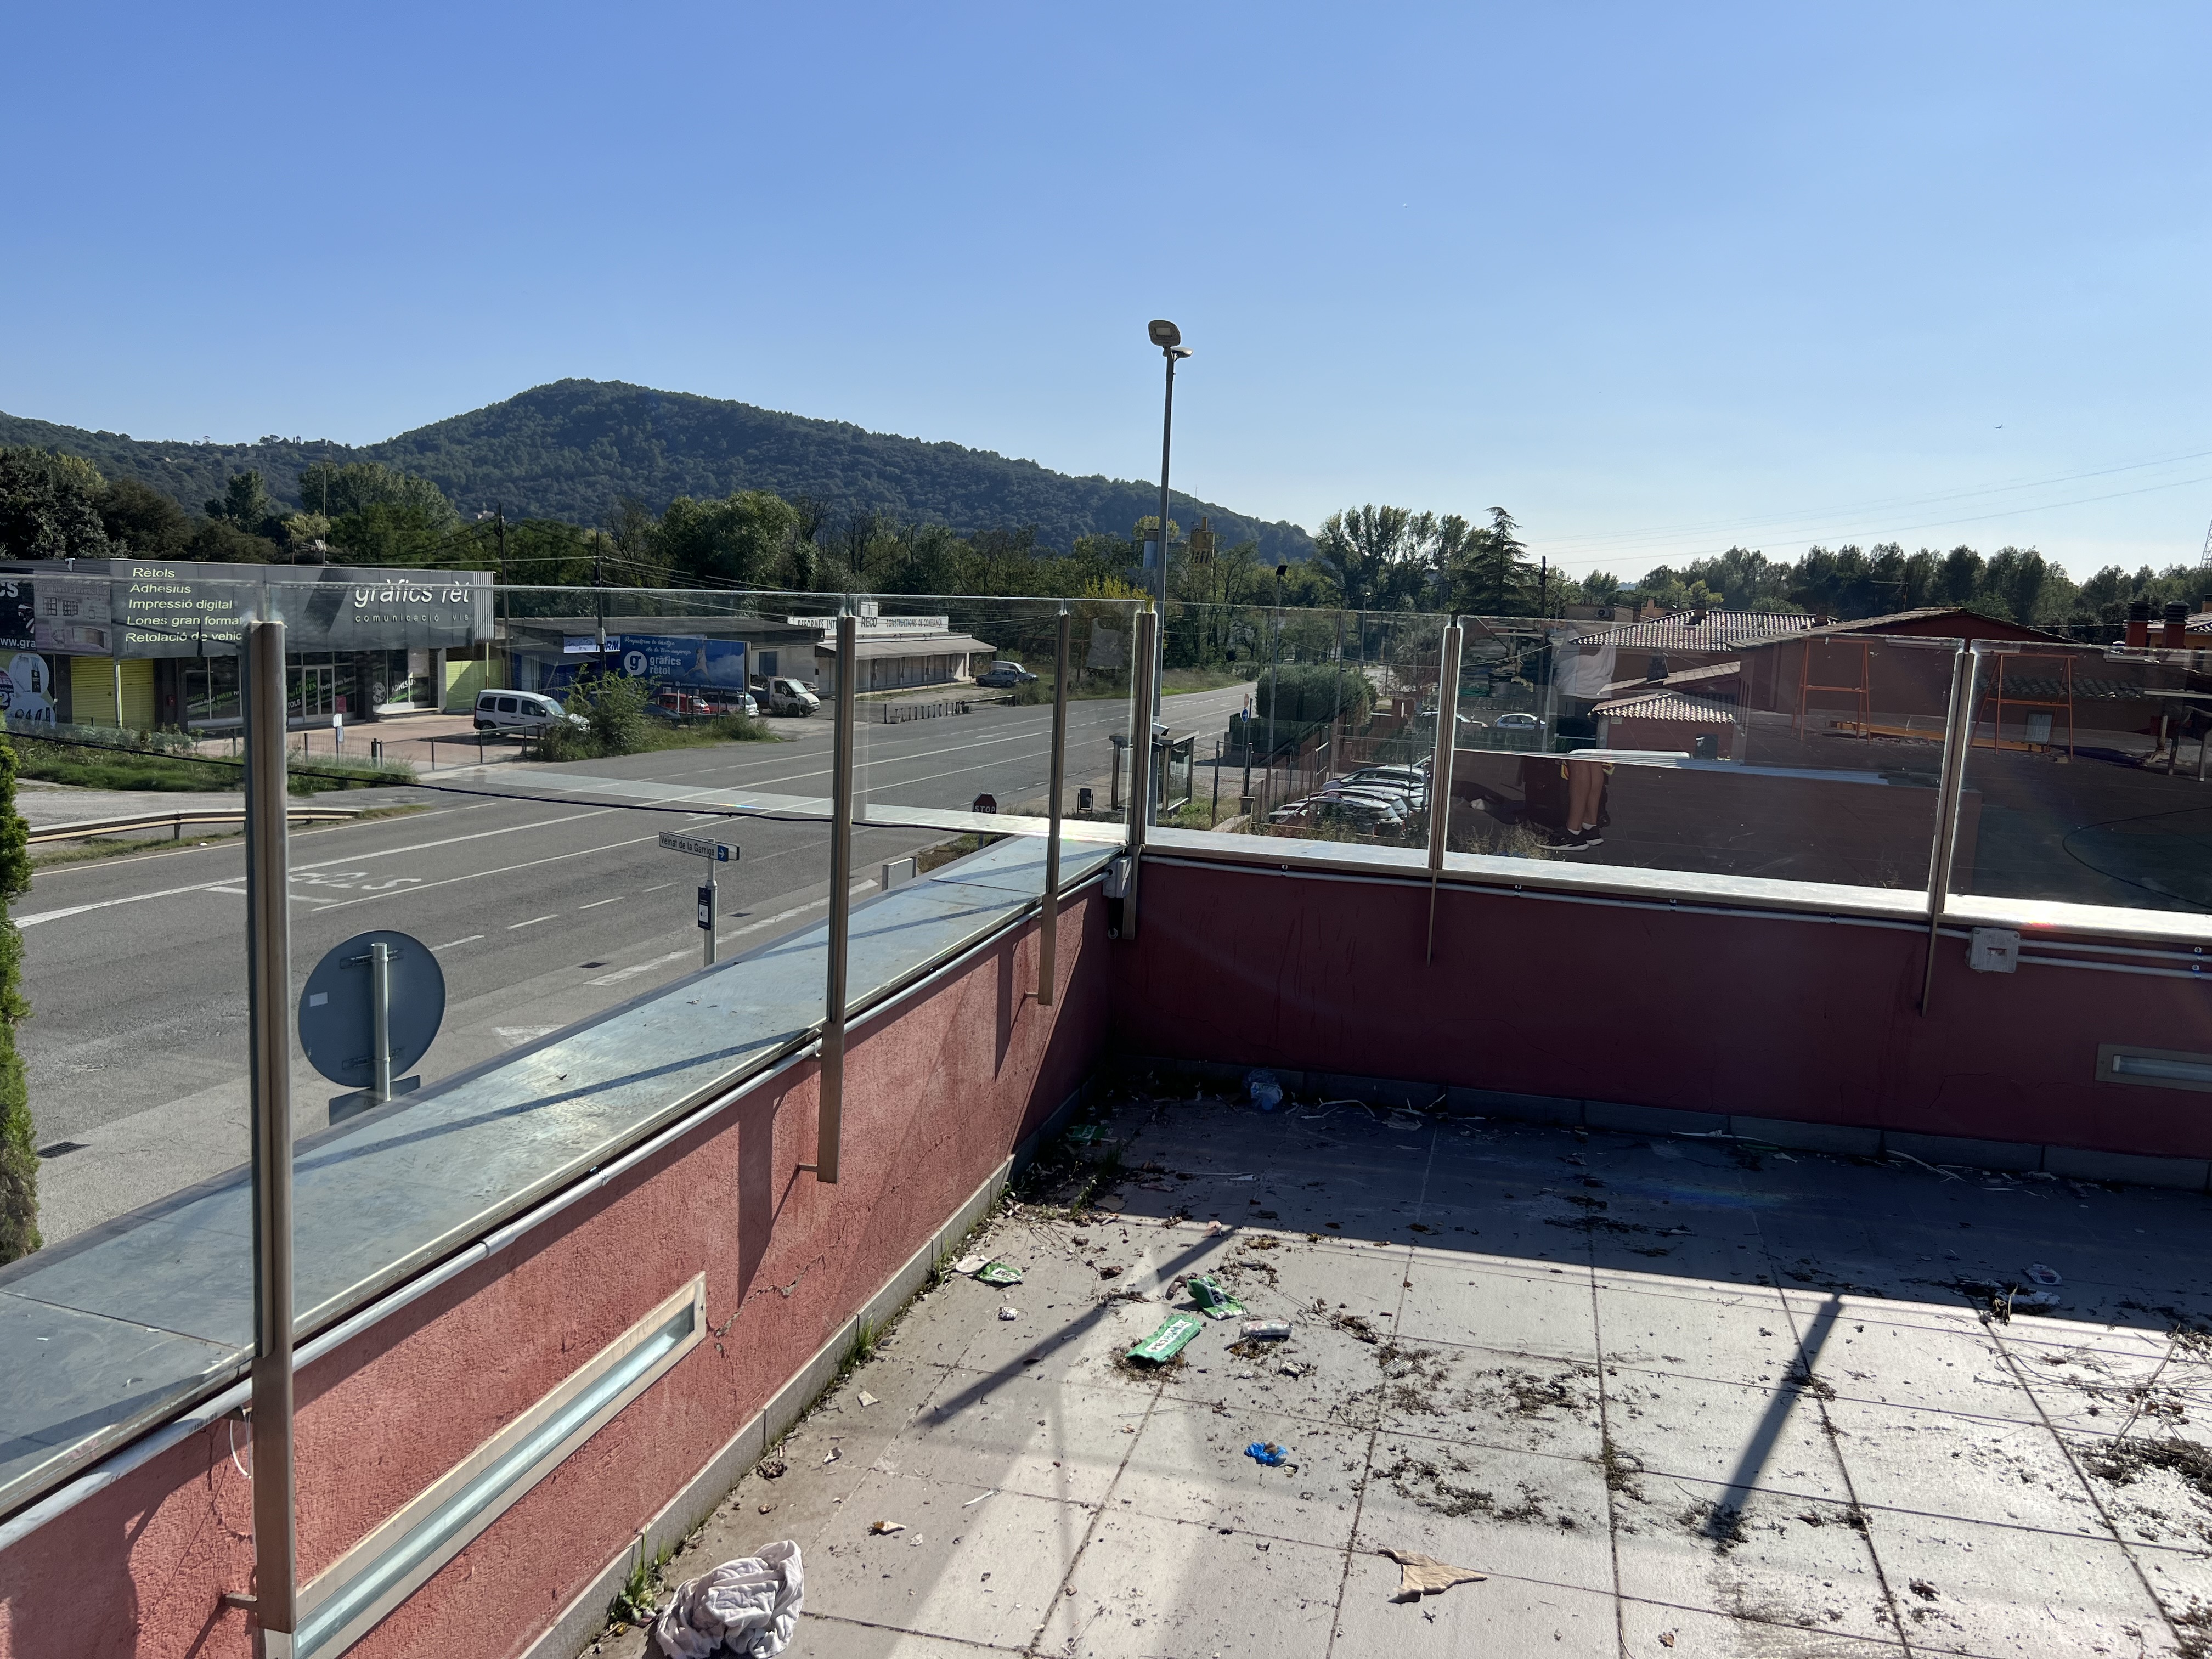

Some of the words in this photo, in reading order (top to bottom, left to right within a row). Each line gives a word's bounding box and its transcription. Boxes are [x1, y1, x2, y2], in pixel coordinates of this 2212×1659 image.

[133, 567, 176, 578] Rètols
[130, 584, 191, 594] Adhesius
[354, 579, 433, 608] gràfics
[129, 599, 193, 611] Impressió
[196, 600, 233, 611] digital
[127, 616, 168, 625] Lones
[172, 617, 201, 627] gran
[356, 613, 439, 622] comunicació
[126, 632, 187, 643] Retolació
[191, 632, 208, 641] de
[650, 655, 681, 666] gràfics
[391, 678, 416, 693] ADHESUS
[974, 805, 996, 814] STOP
[679, 840, 686, 850] de
[687, 841, 692, 851] la
[694, 843, 715, 857] Garriga
